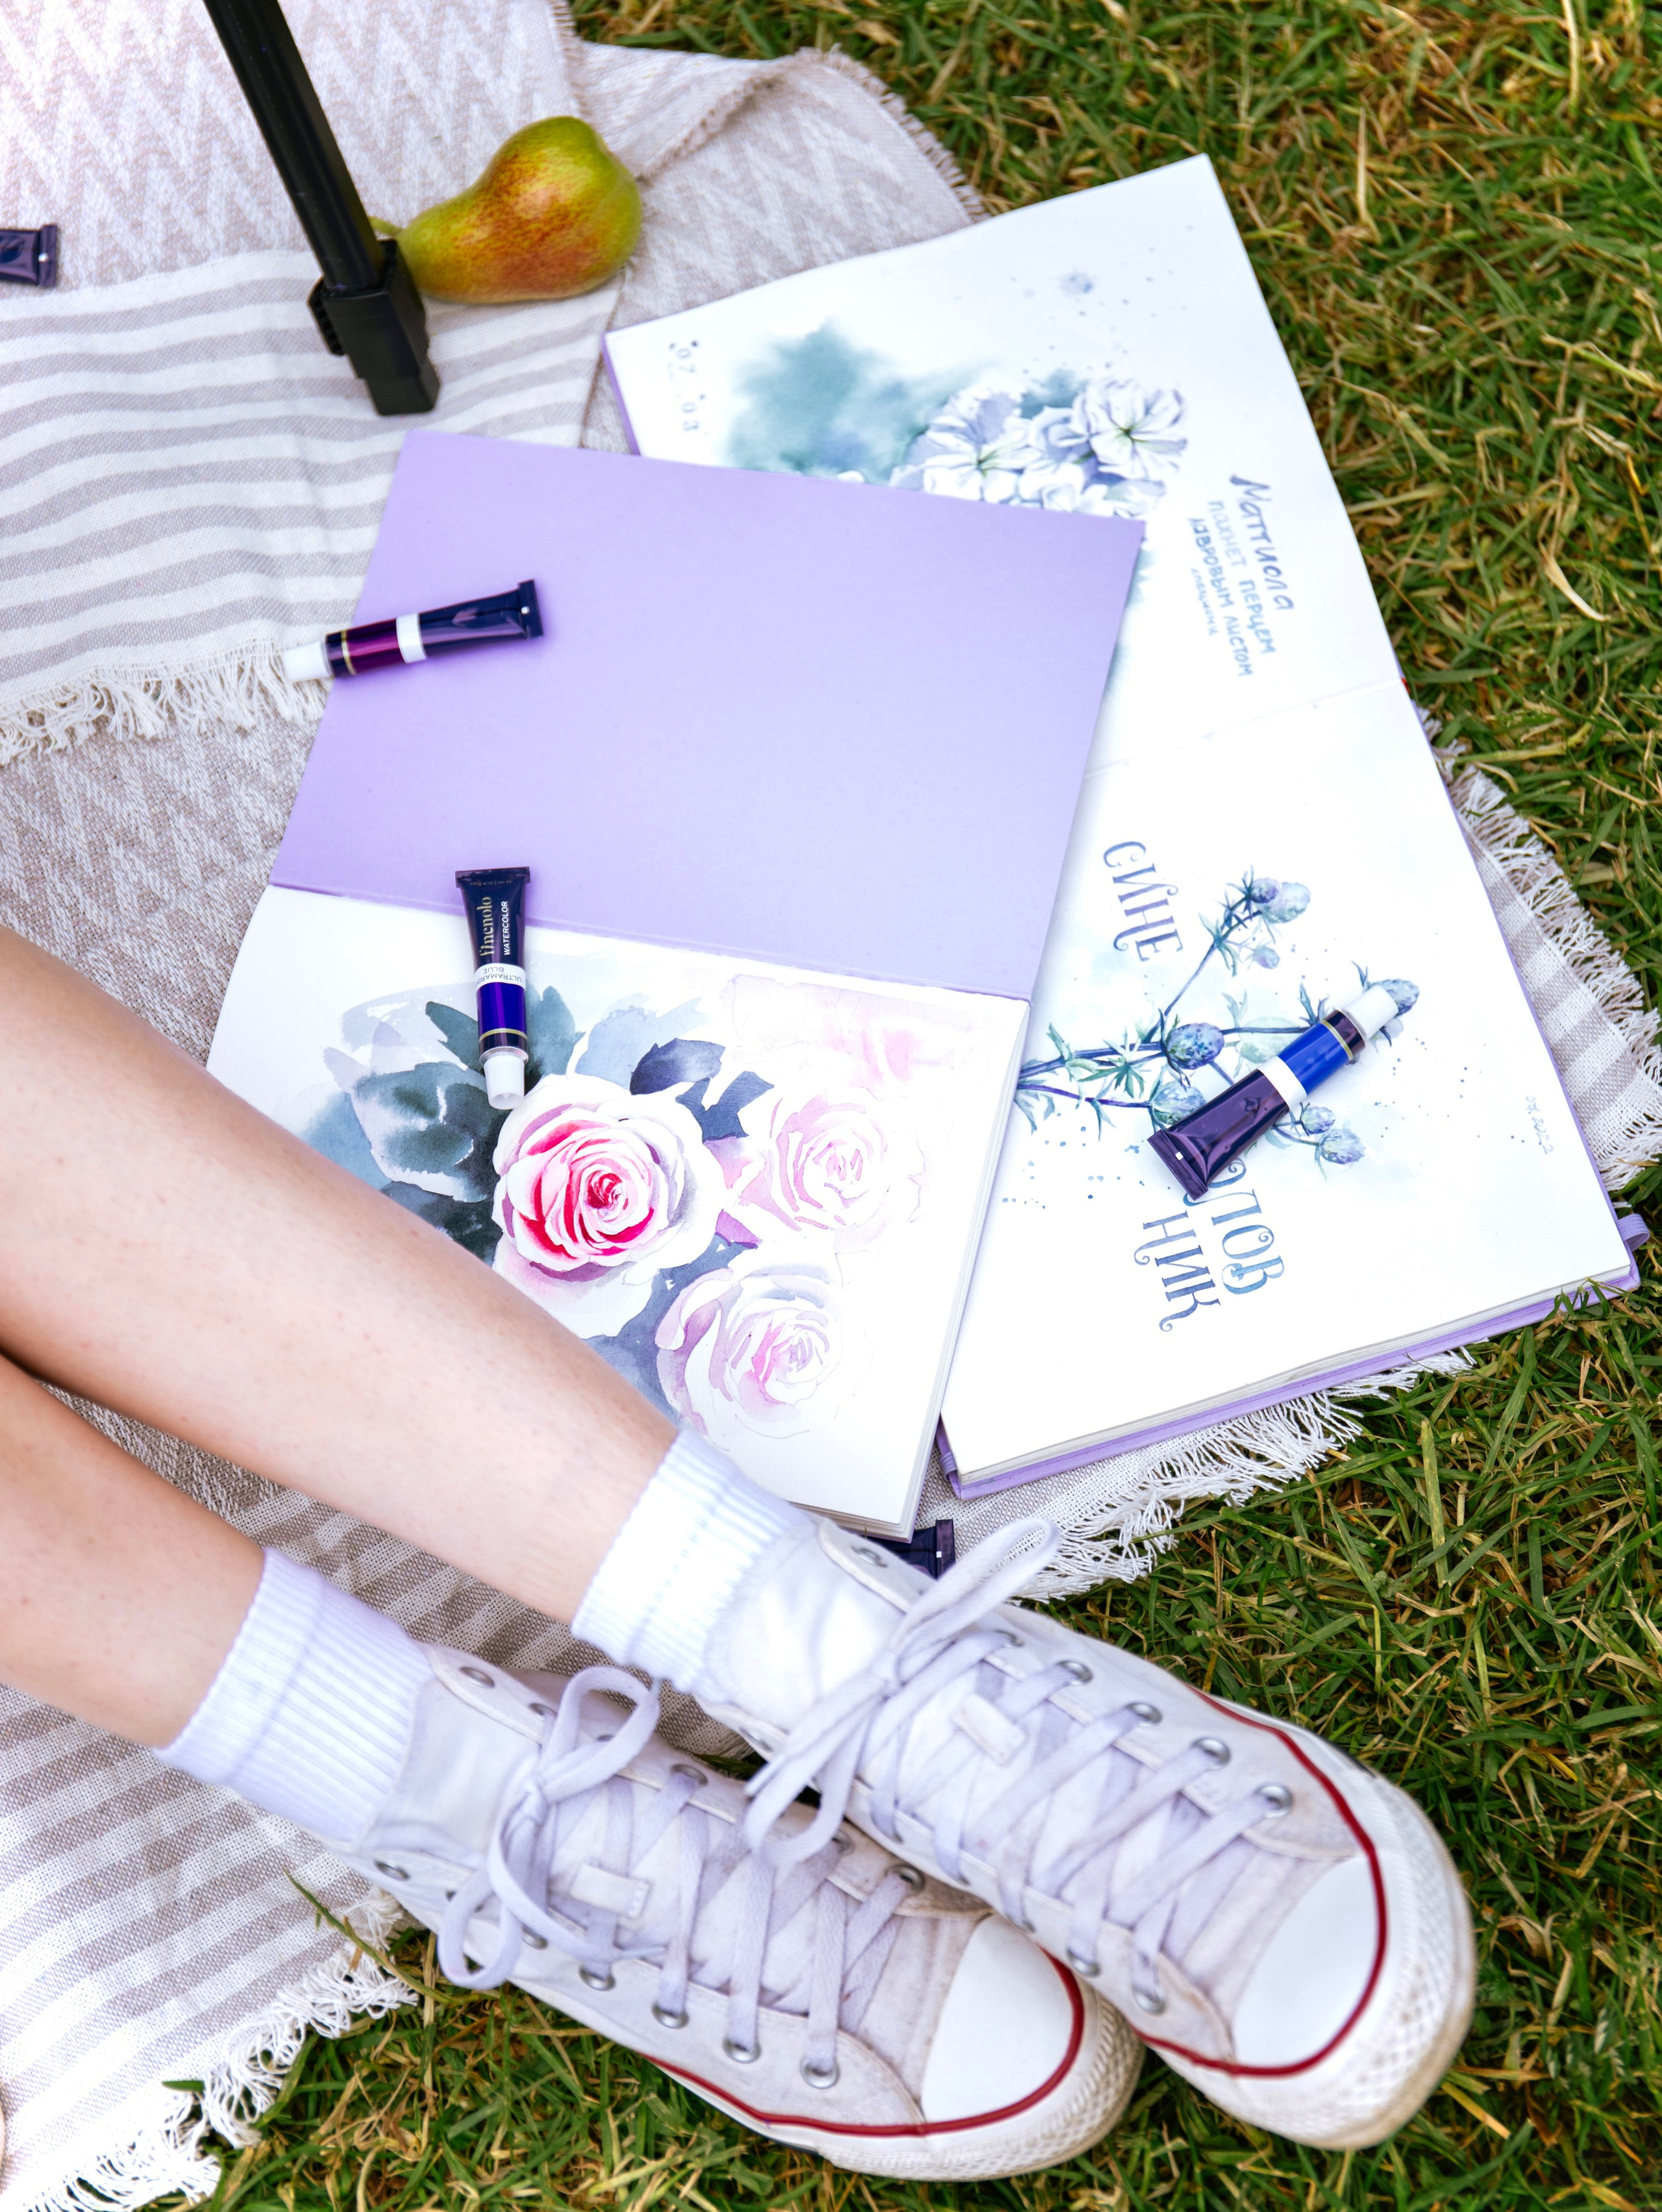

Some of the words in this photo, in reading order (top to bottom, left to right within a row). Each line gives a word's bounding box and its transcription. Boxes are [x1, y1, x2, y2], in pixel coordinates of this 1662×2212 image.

[1229, 474, 1294, 610] Маттиола
[1239, 579, 1276, 654] ПЕРЦЕМ
[477, 897, 495, 956] finenolo
[501, 901, 511, 956] WATERCOLOR
[1103, 841, 1184, 962] СИНЕ
[475, 973, 522, 987] ULTRAMARIN
[1134, 1210, 1221, 1332] НИК
